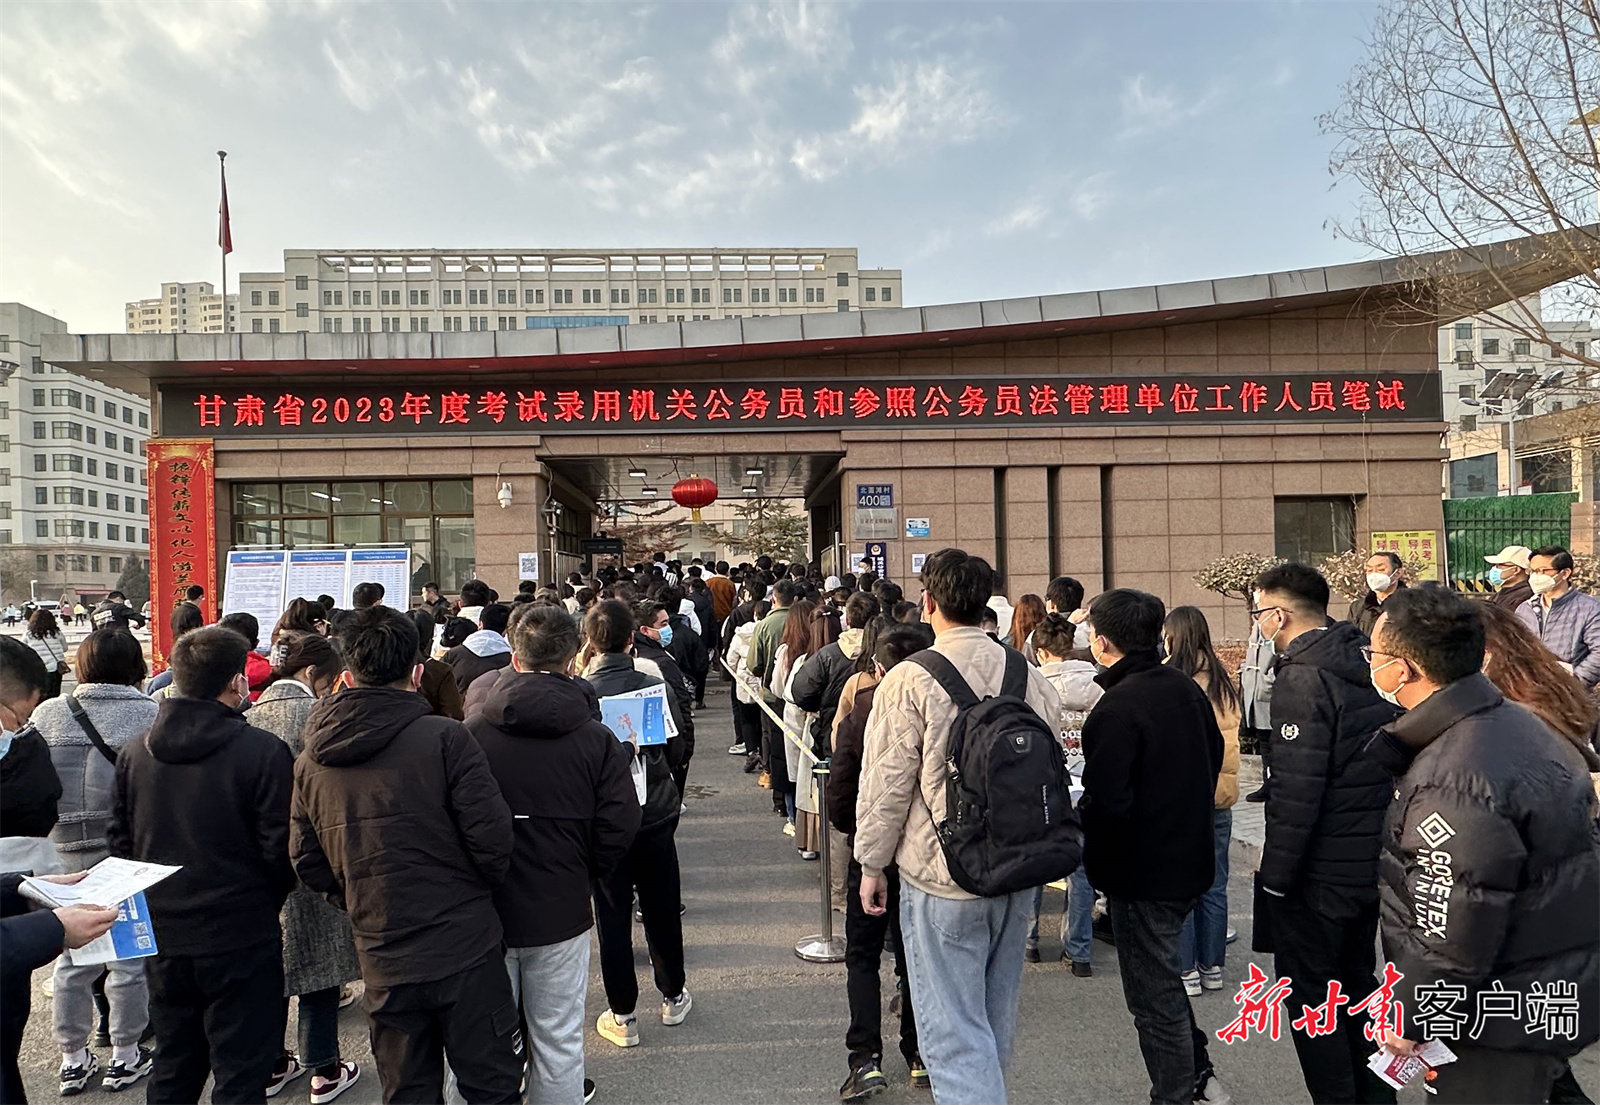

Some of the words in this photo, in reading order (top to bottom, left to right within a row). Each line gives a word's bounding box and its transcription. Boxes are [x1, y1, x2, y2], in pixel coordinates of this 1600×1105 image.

[193, 379, 1407, 428] 甘肃省2023年度考试录用机关公务员和参照公务员法管理单位工作人员笔试
[859, 495, 880, 506] 400
